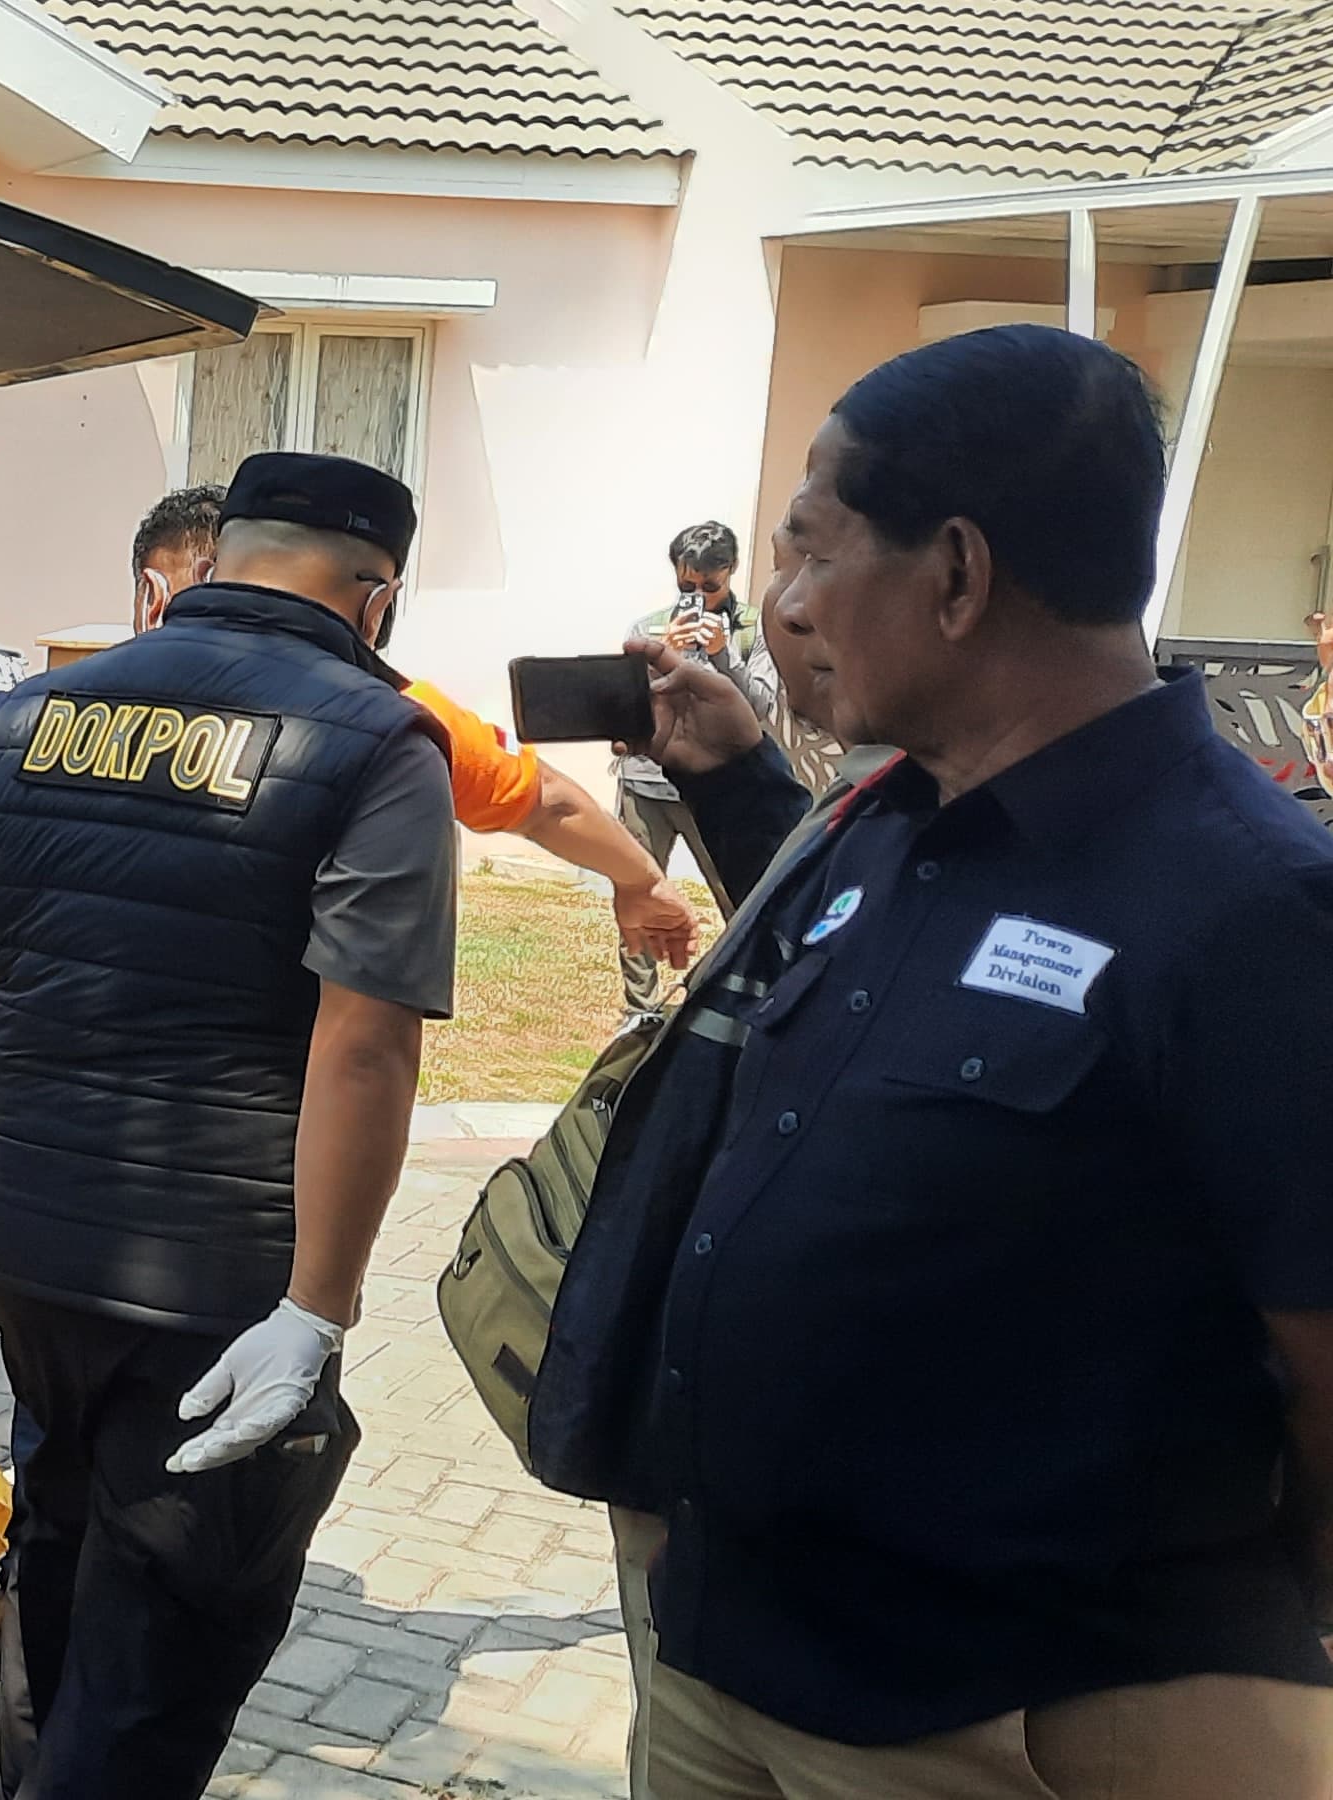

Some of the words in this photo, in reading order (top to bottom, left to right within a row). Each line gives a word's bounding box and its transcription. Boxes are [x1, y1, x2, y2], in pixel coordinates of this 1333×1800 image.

[23, 698, 253, 800] DOKPOL
[1022, 928, 1073, 955] Town
[989, 943, 1084, 979] Management
[986, 963, 1062, 996] Division
